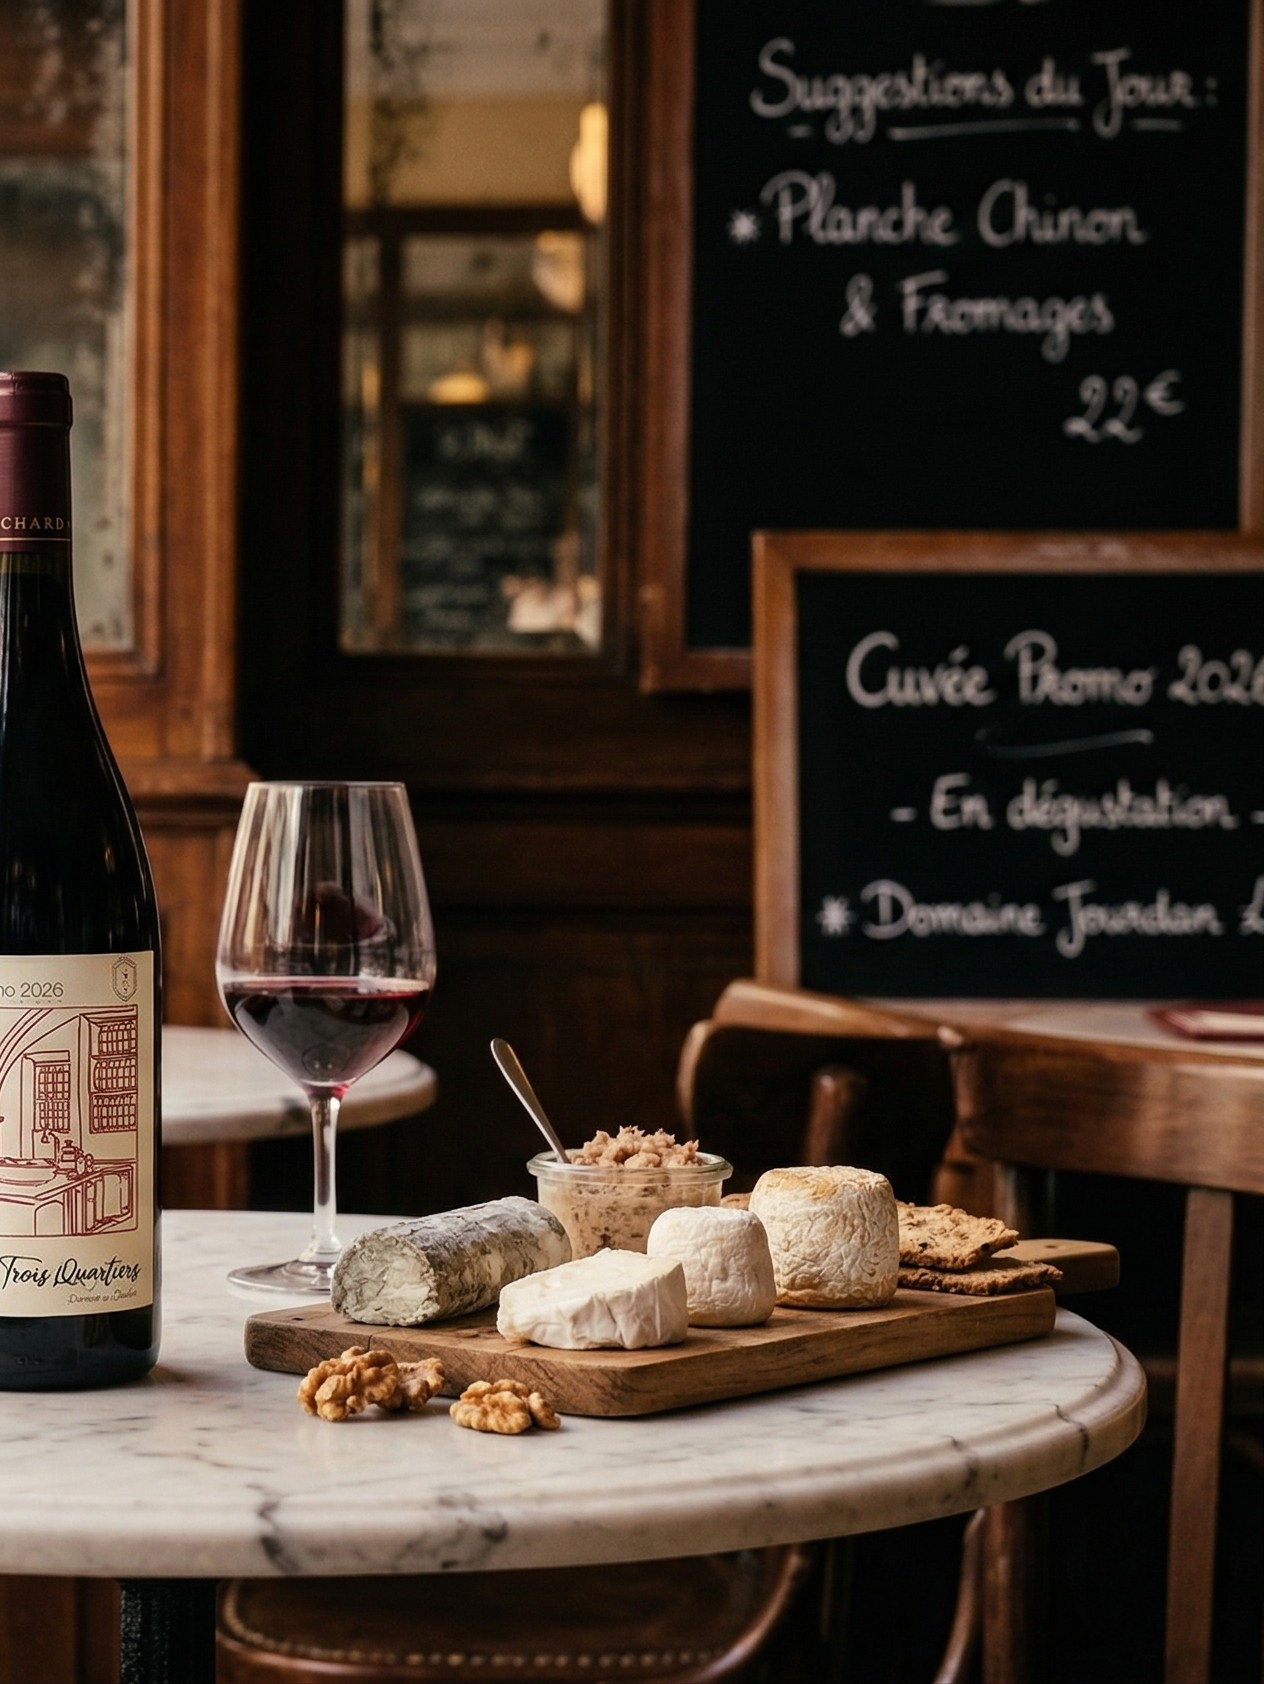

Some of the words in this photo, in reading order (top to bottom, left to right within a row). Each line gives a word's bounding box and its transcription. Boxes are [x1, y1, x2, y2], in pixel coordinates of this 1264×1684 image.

[750, 37, 1015, 143] Suggestions
[1025, 55, 1083, 108] du
[760, 170, 958, 246] Planche
[977, 178, 1146, 247] Chinon
[840, 273, 876, 338] &
[899, 269, 1115, 362] Fromages
[1063, 370, 1185, 443] 22€
[845, 630, 995, 708] Cuvée
[1004, 629, 1156, 706] Promo
[929, 772, 995, 831] En
[1006, 777, 1239, 857] dégustation
[860, 878, 1047, 940] Domaine
[1052, 878, 1225, 960] Jourdan
[20, 982, 64, 998] 2026
[52, 1254, 142, 1292] Quartiers
